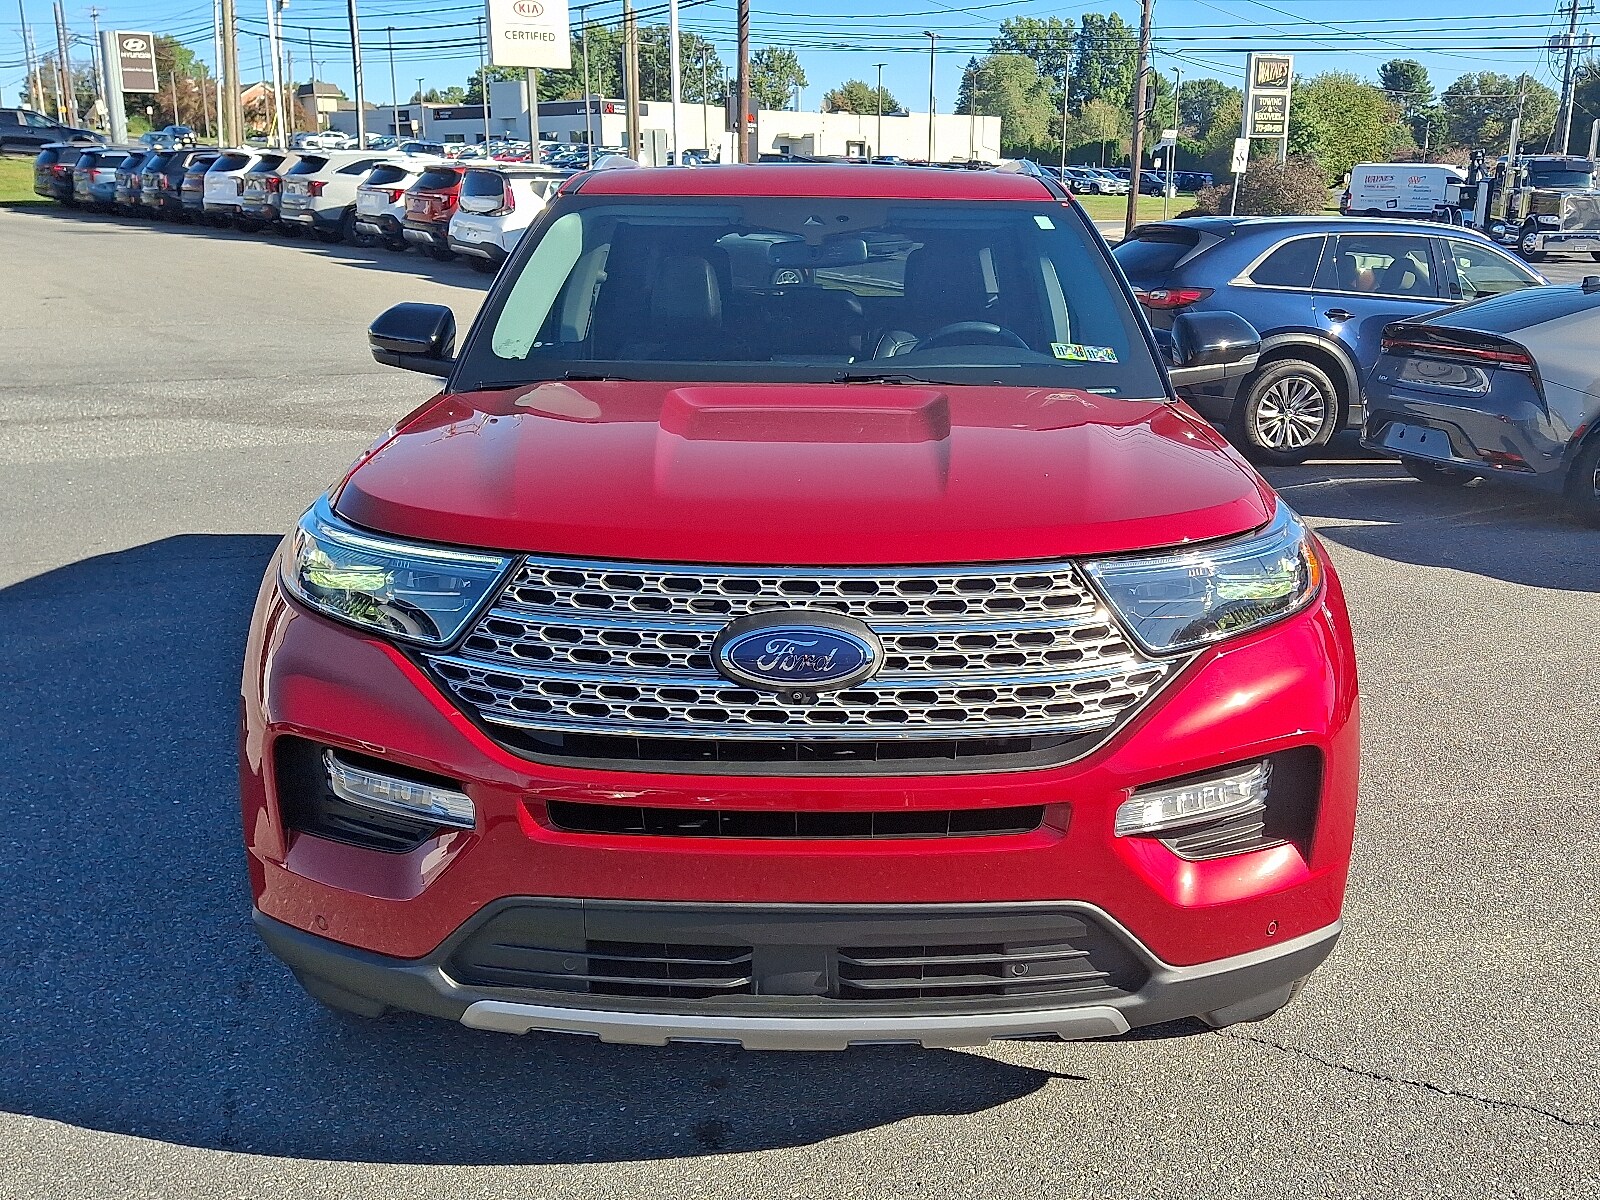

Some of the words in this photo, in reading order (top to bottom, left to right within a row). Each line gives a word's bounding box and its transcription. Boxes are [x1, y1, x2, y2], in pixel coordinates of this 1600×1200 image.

[518, 3, 539, 14] KIA
[504, 30, 556, 42] CERTIFIED
[1259, 97, 1283, 106] TOWING
[756, 638, 838, 672] Ford
